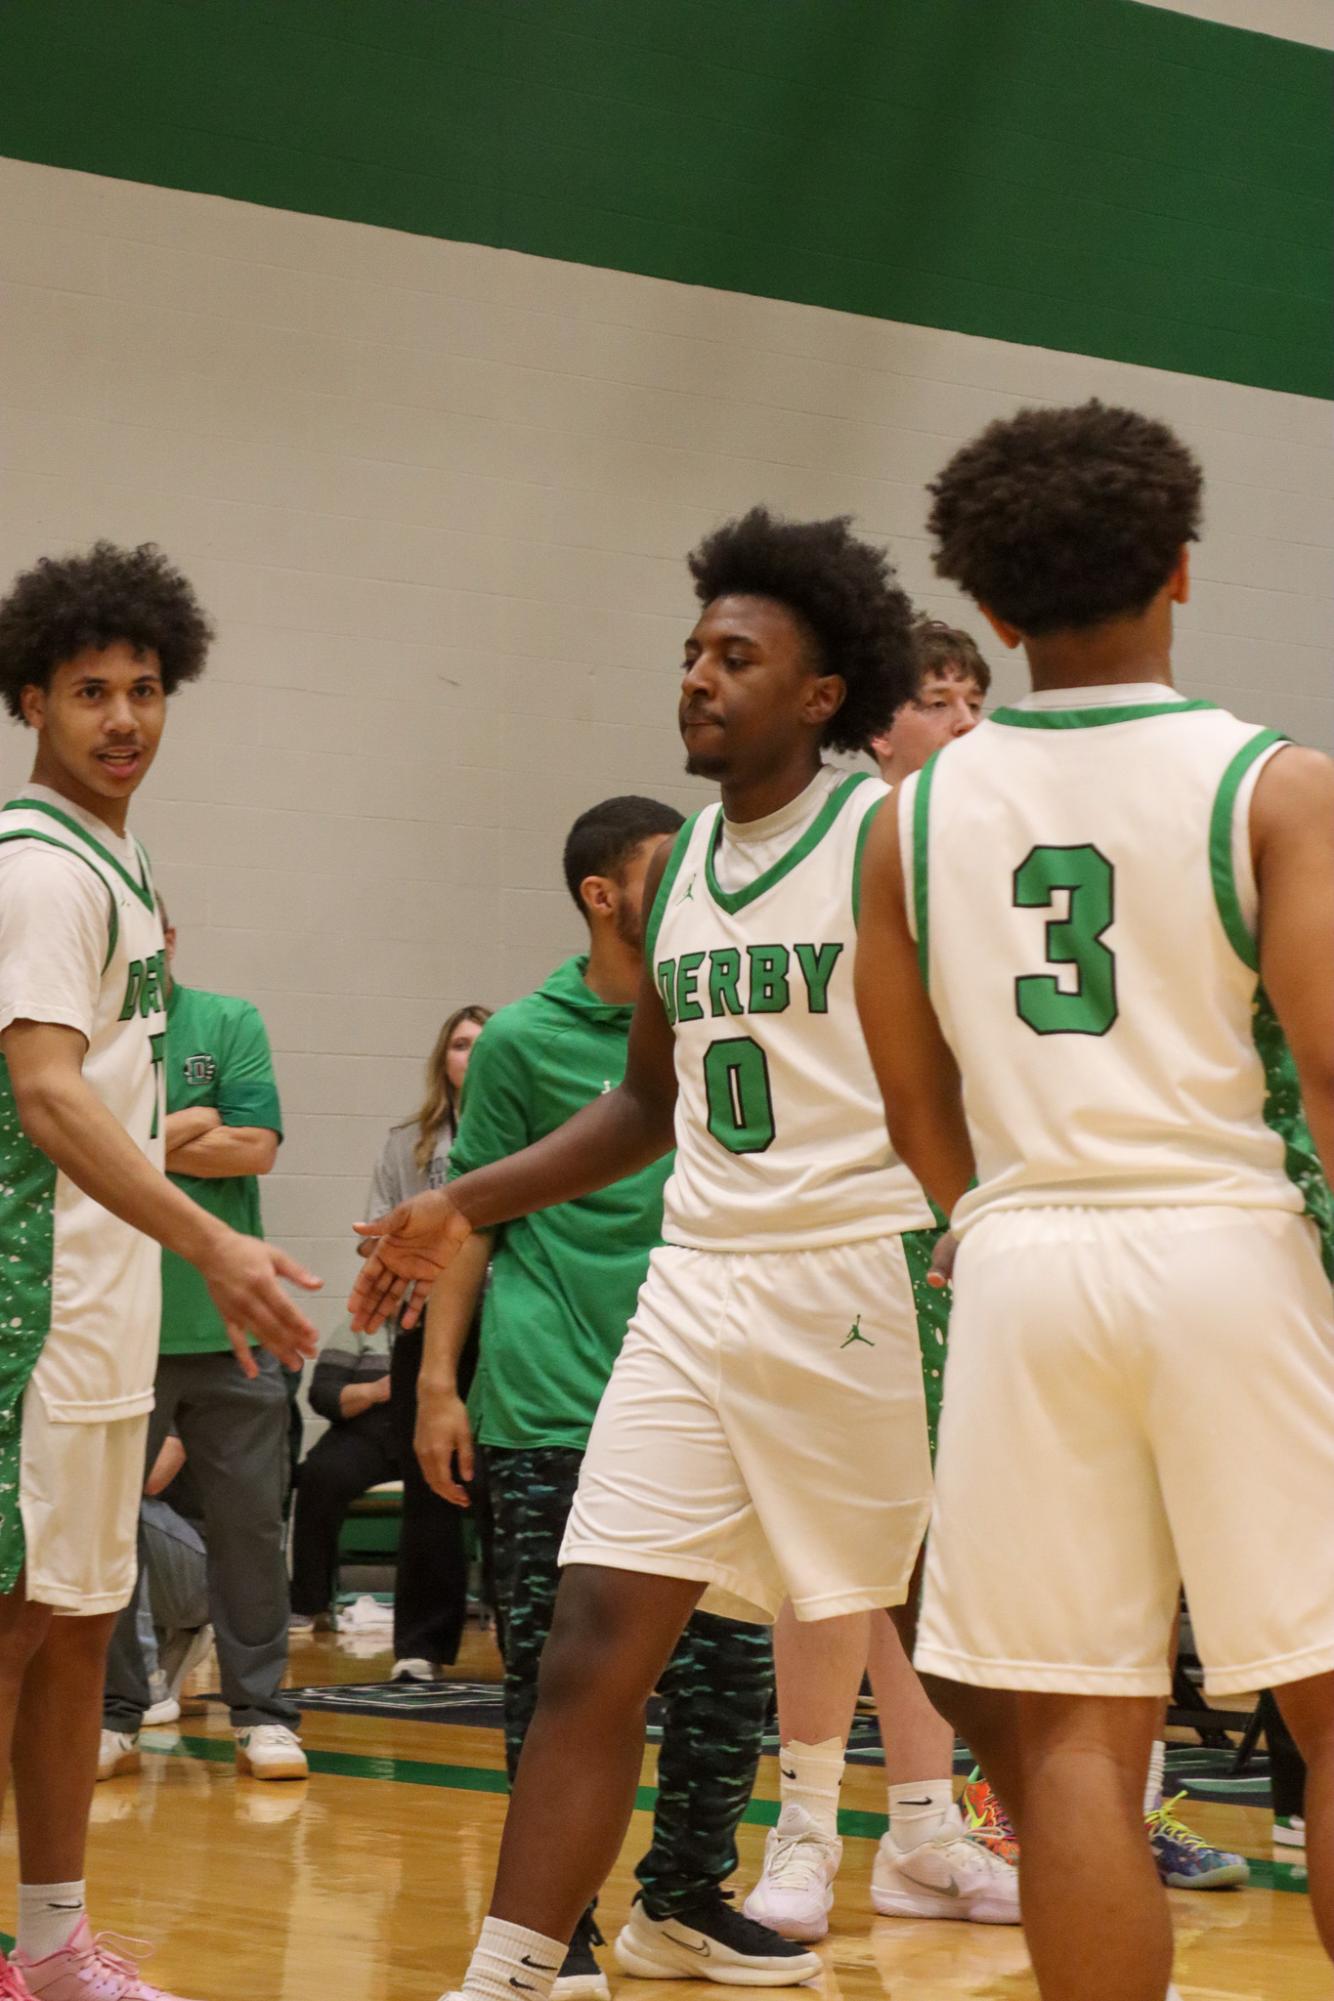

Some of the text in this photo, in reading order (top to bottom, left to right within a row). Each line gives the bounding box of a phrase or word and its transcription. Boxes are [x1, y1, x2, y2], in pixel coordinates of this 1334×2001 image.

[657, 943, 844, 1026] DERBY
[1012, 843, 1119, 1036] 3
[703, 1036, 776, 1155] 0
